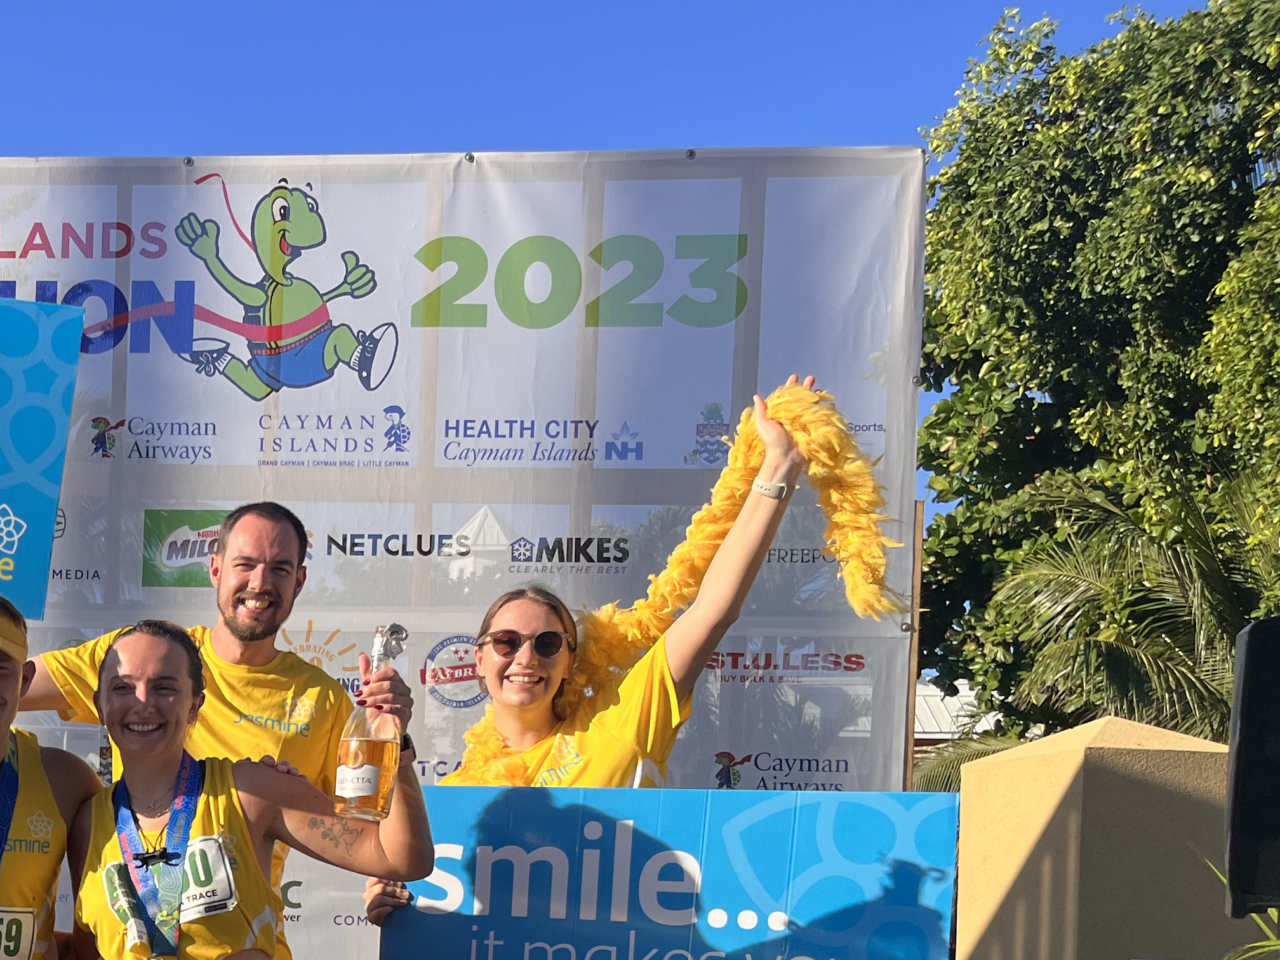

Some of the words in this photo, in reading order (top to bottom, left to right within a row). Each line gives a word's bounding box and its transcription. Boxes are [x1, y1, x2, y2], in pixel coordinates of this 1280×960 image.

[410, 234, 749, 329] 2023
[127, 416, 218, 441] Cayman
[258, 414, 376, 430] CAYMAN
[444, 419, 535, 438] HEALTH
[545, 419, 600, 439] CITY
[127, 440, 212, 465] Airways
[258, 437, 375, 453] ISLANDS
[443, 440, 526, 467] Cayman
[531, 441, 599, 462] Islands
[606, 441, 644, 461] NH
[327, 533, 472, 558] NETCLUES
[535, 536, 630, 564] MIKES
[52, 569, 101, 580] MEDIA
[508, 565, 564, 574] CLEARLY
[569, 565, 593, 574] THE
[597, 565, 629, 575] BEST
[717, 675, 736, 683] BUY
[739, 675, 766, 684] BULK
[778, 675, 803, 684] SAVE
[753, 752, 850, 777] Cayman
[185, 889, 219, 903] TRACE
